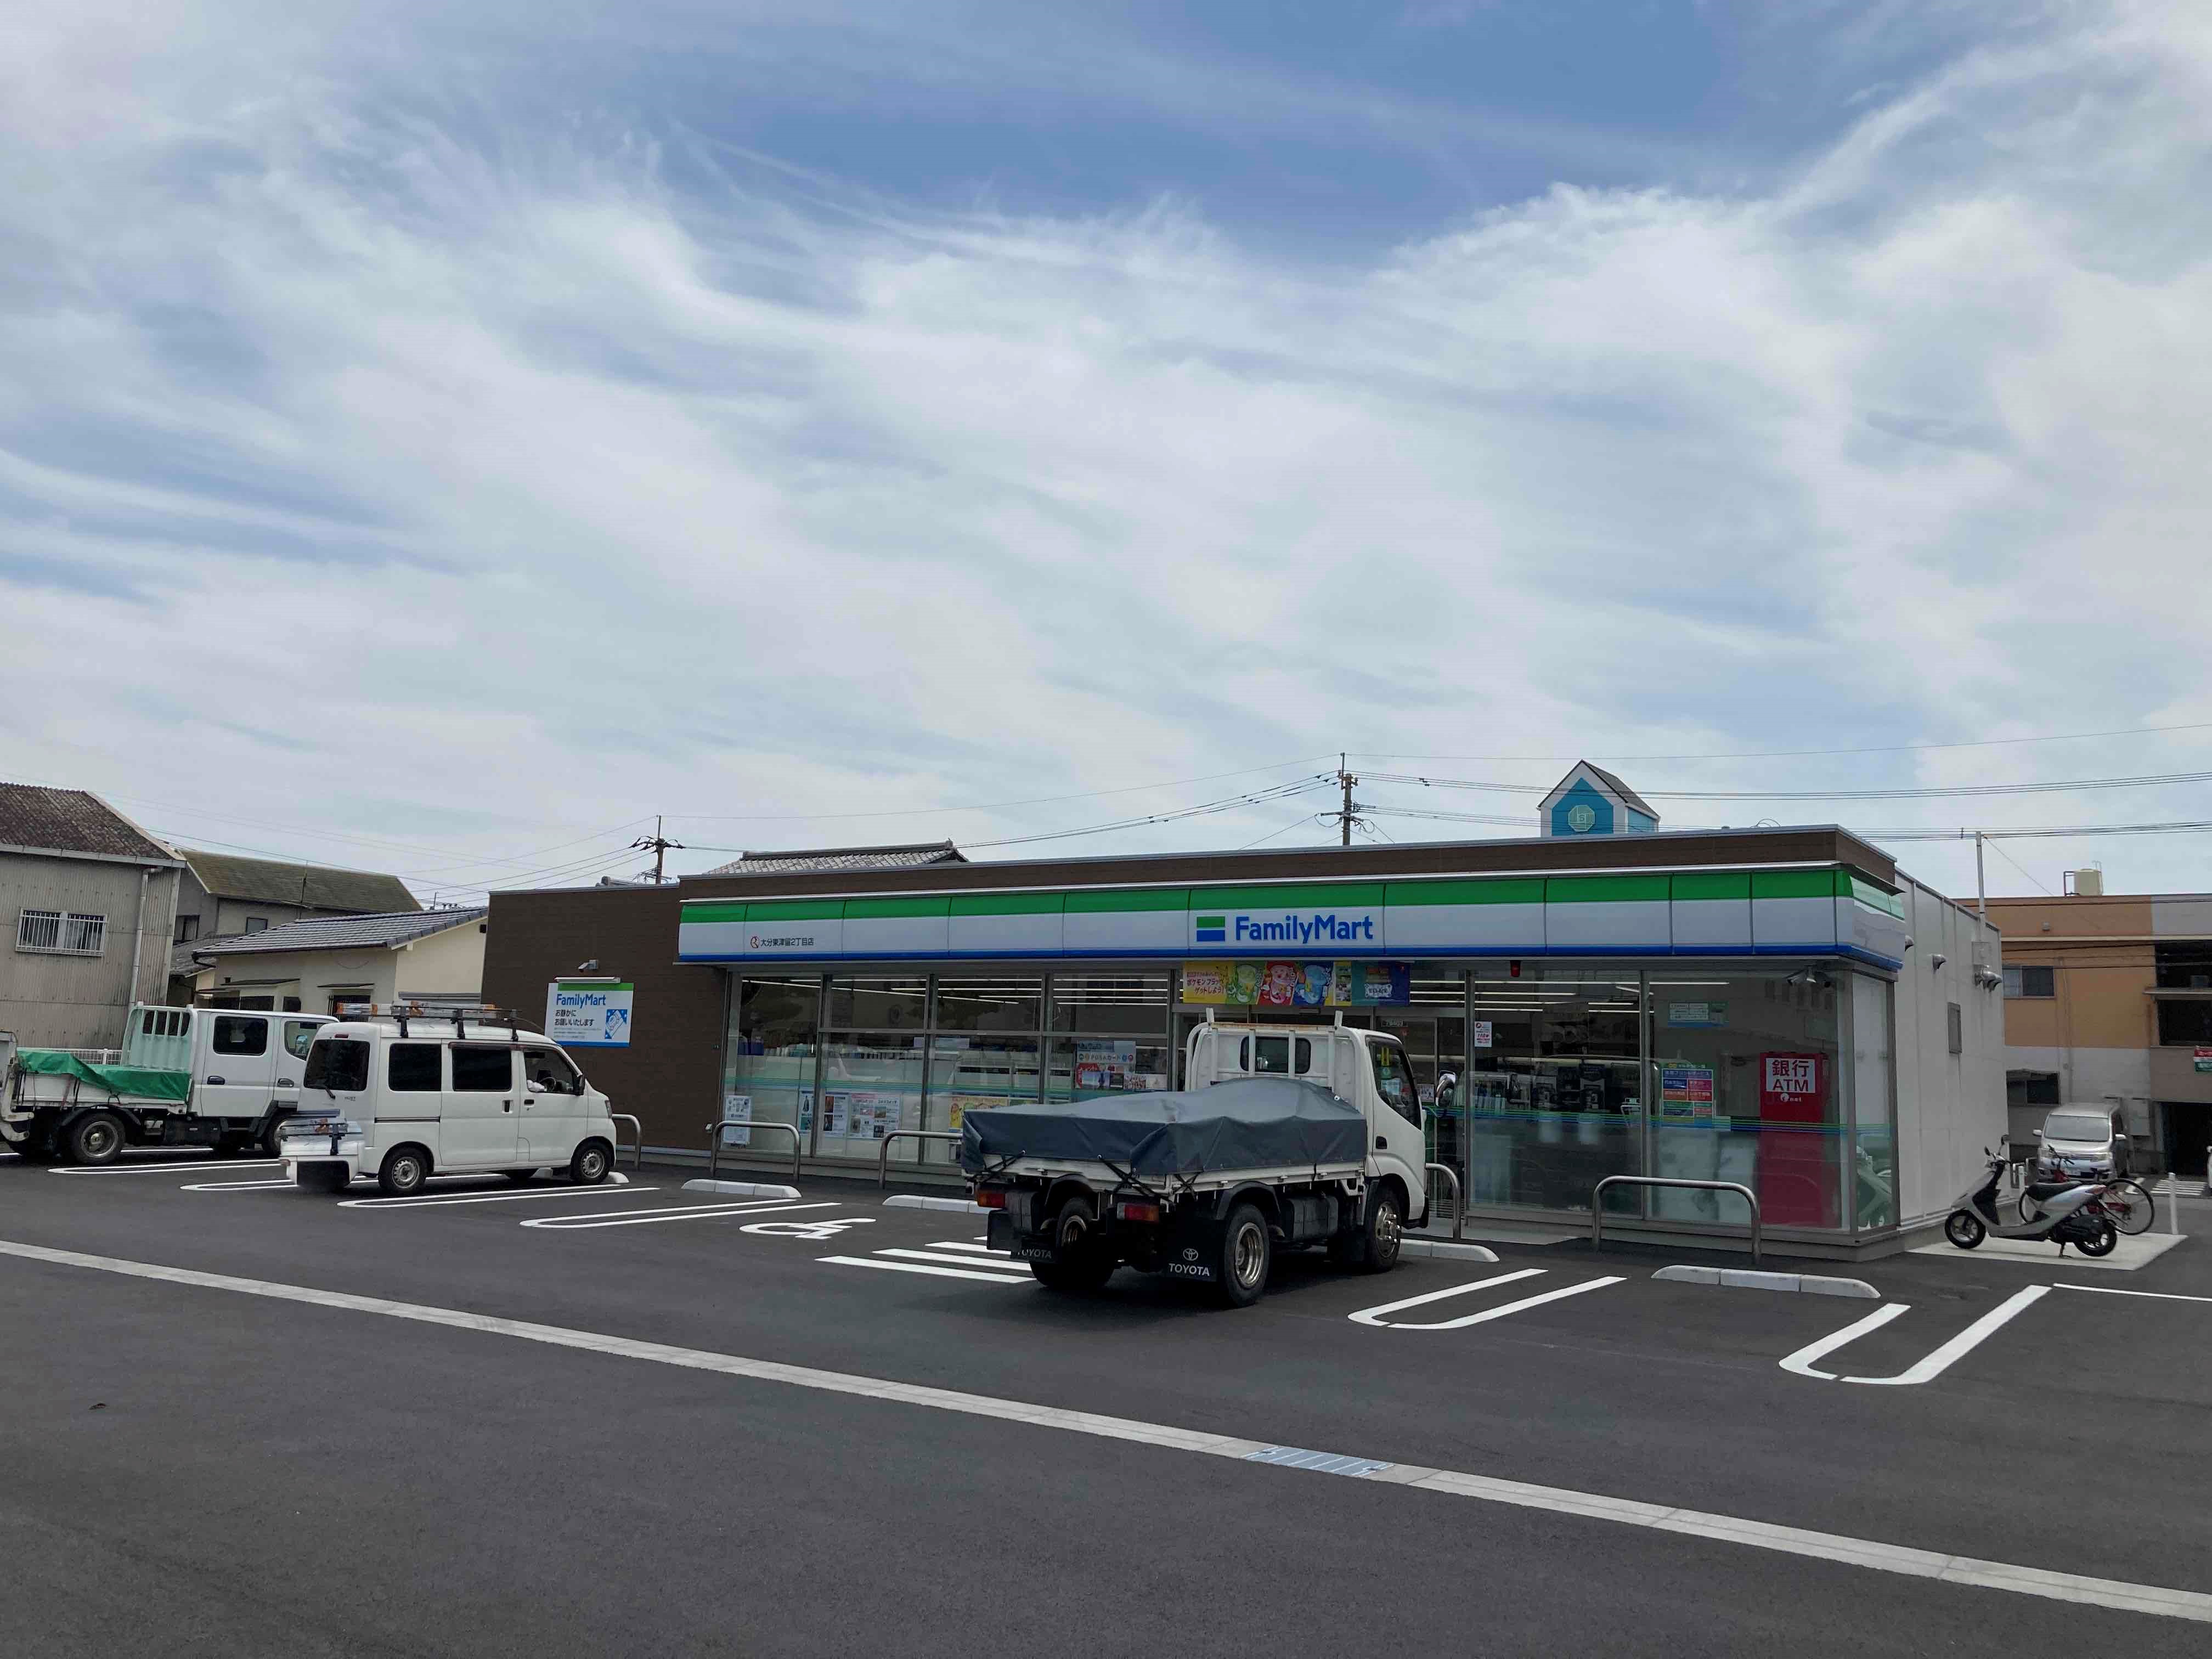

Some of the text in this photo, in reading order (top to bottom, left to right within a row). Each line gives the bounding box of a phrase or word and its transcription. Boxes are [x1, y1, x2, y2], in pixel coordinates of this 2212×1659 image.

[1235, 915, 1373, 944] FamilyMart
[556, 993, 606, 1009] FamilyMart
[1772, 1059, 1809, 1077] 銀行
[1773, 1079, 1809, 1092] ATM
[1168, 1263, 1210, 1276] TOYOTA
